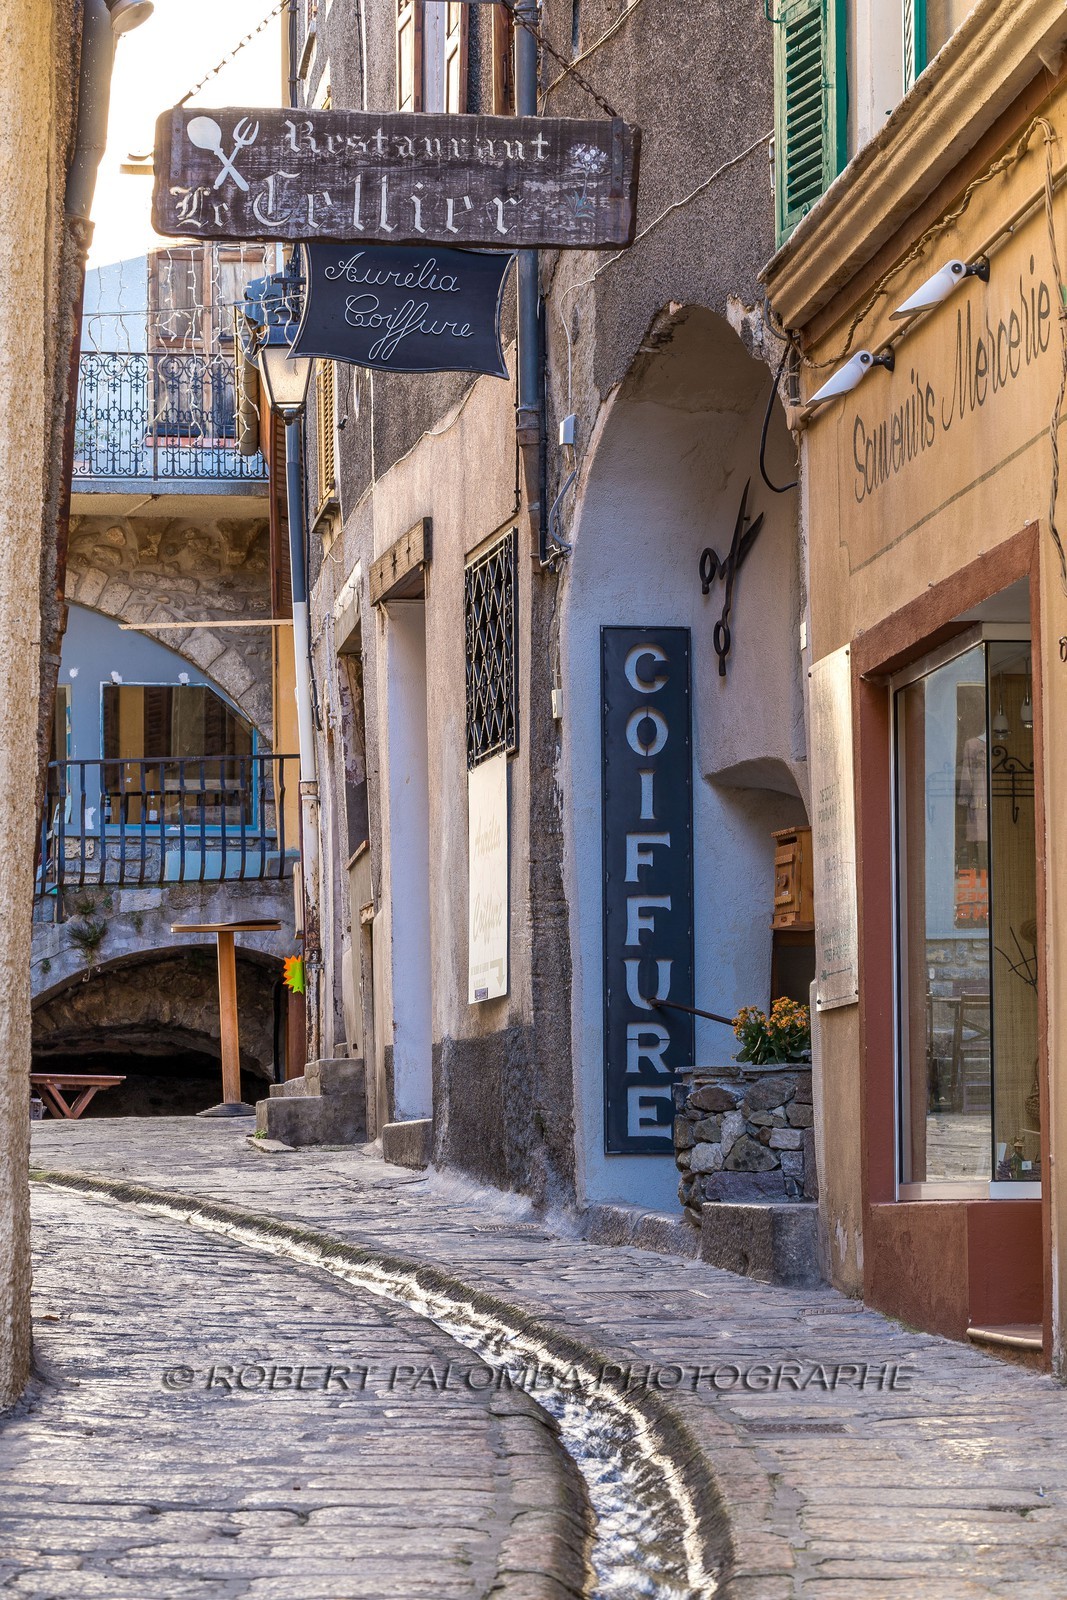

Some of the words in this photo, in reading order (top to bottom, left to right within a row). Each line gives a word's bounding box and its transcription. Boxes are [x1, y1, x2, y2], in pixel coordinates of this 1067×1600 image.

[282, 118, 550, 163] Restaurant
[169, 186, 231, 228] Le
[252, 170, 525, 236] Cellier
[324, 250, 462, 293] Aurélia
[343, 293, 475, 361] Coiffure
[941, 253, 1051, 432] Mercerie
[623, 642, 673, 1140] COIFFURE
